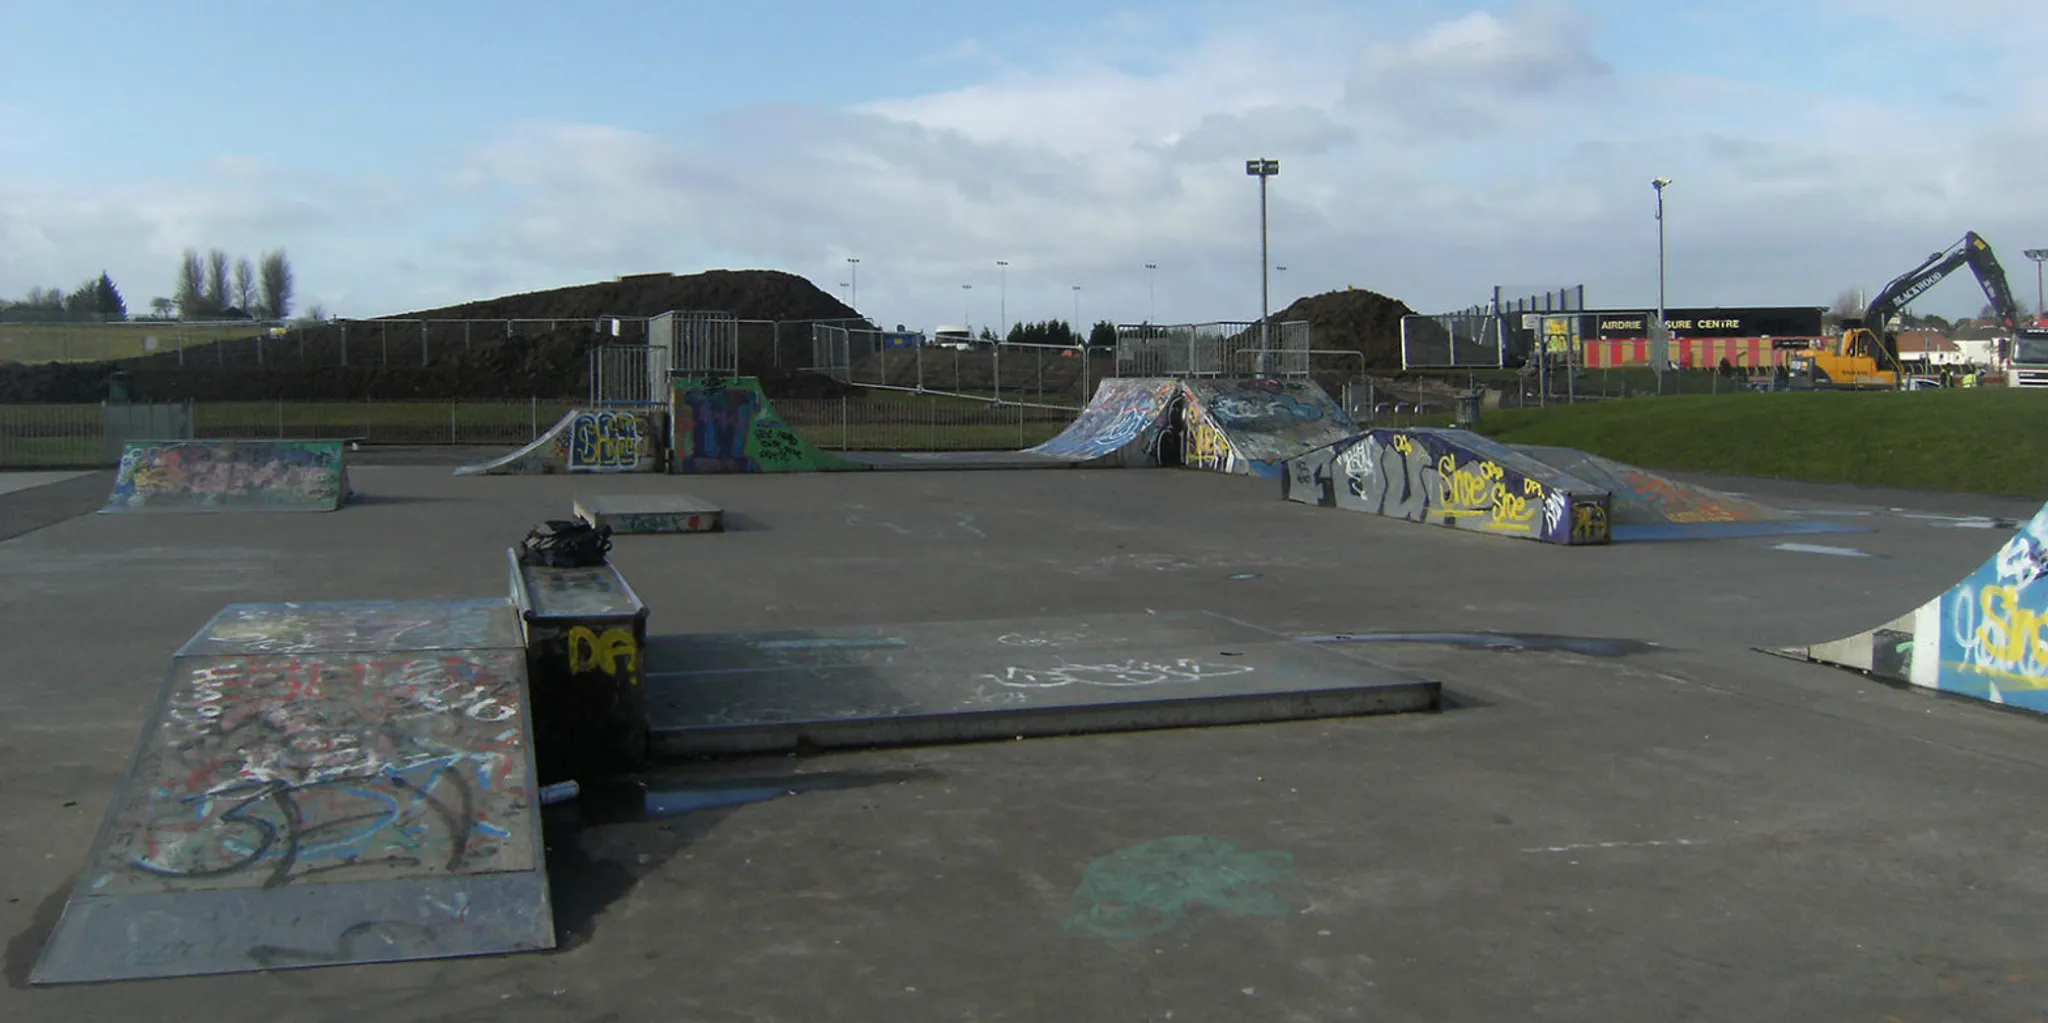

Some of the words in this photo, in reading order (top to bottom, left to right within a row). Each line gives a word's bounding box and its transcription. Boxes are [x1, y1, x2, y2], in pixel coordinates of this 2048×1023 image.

[1892, 271, 1942, 306] BLACKWOOD
[1601, 321, 1641, 330] AIRDRIE
[1697, 320, 1740, 329] CENTRE
